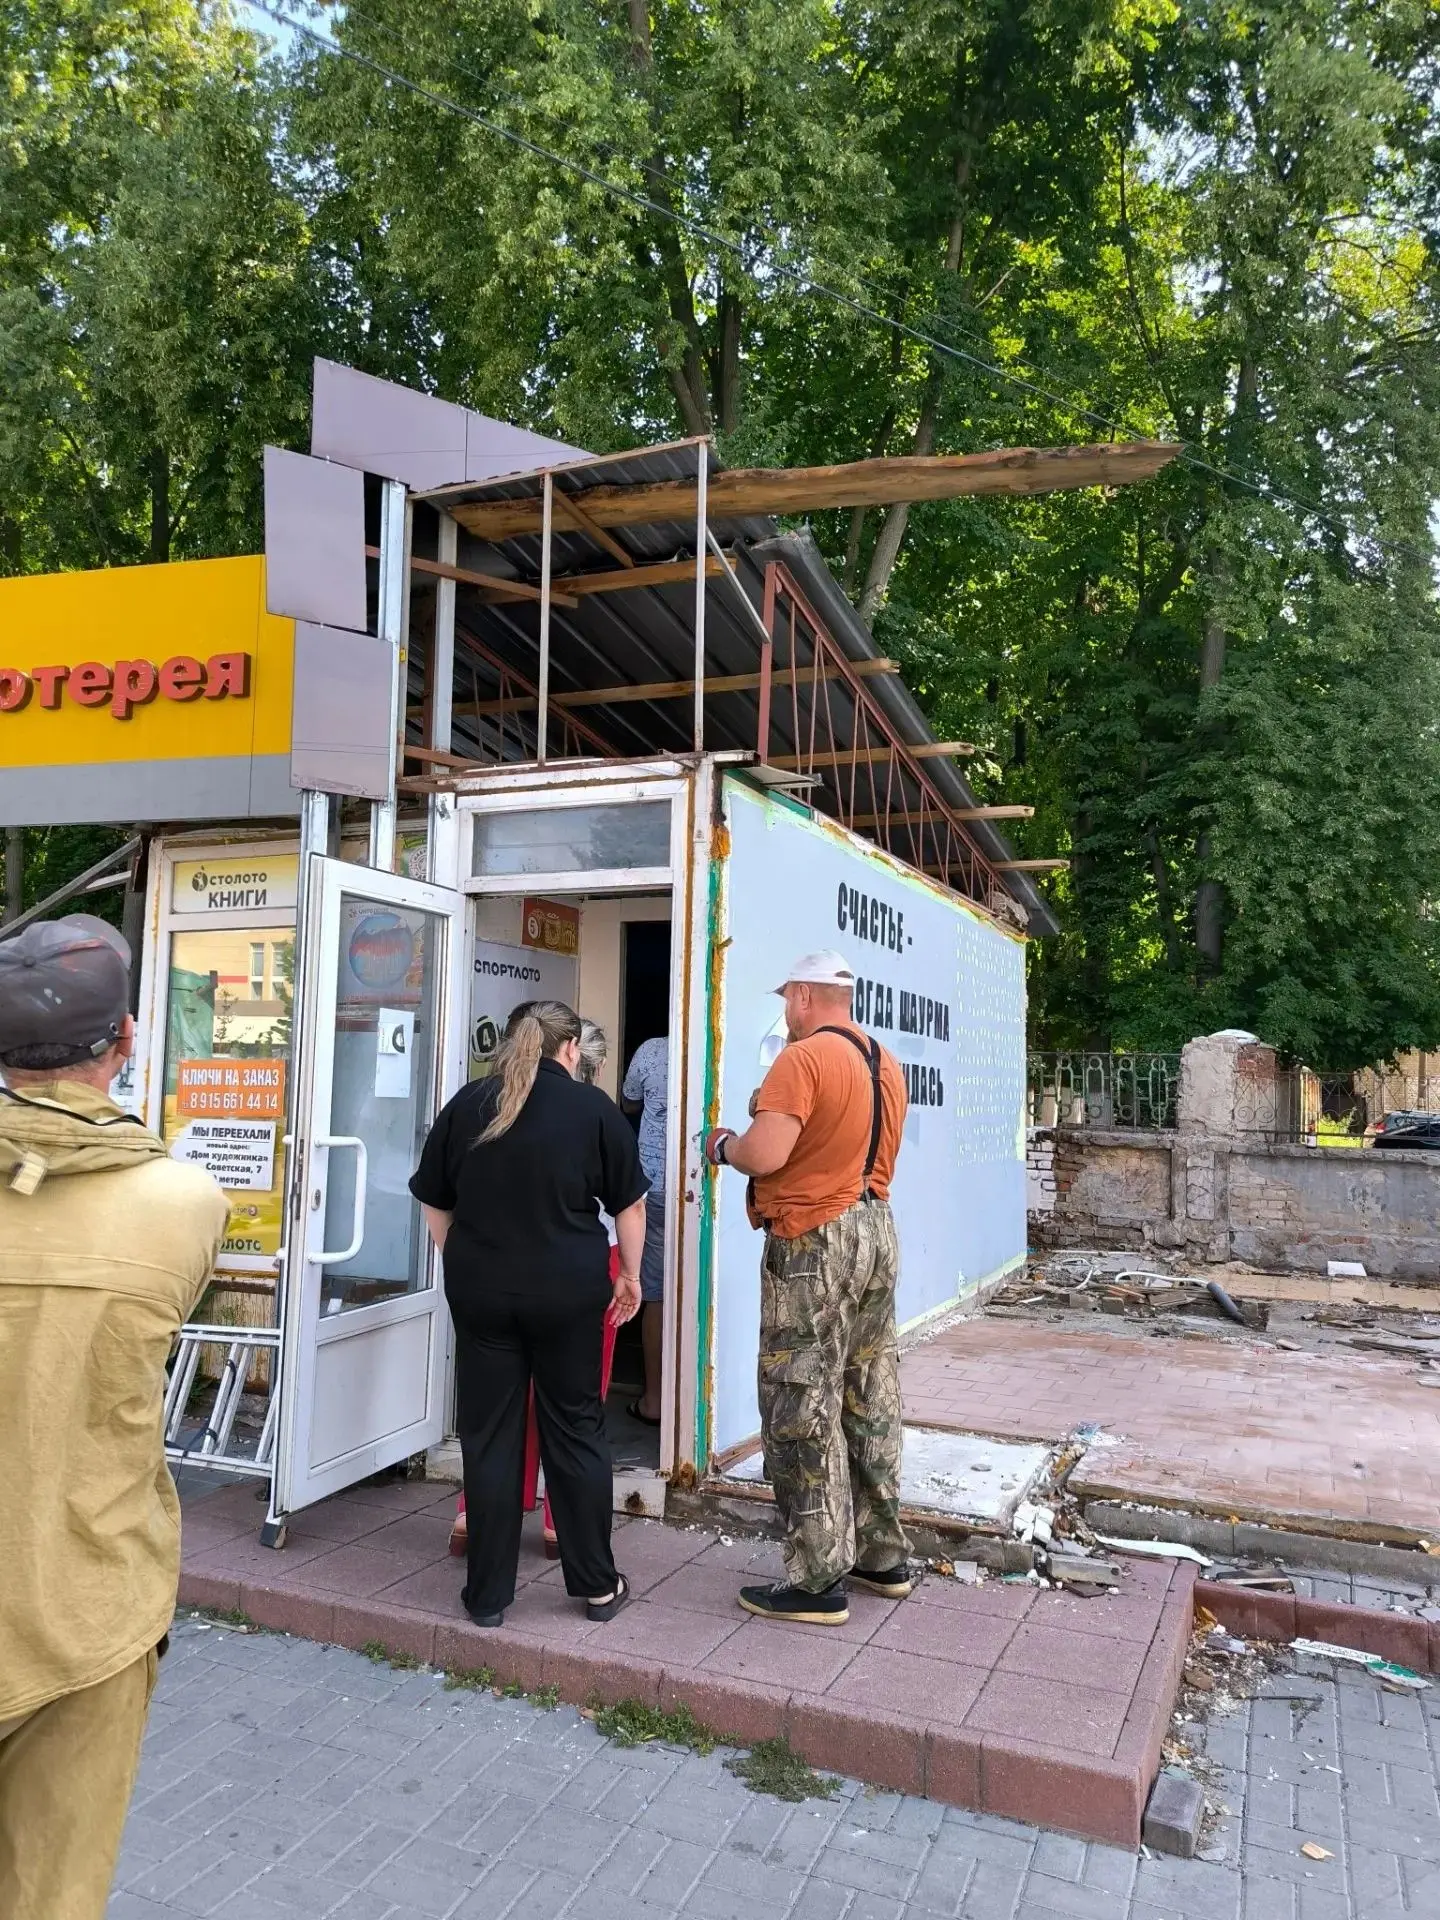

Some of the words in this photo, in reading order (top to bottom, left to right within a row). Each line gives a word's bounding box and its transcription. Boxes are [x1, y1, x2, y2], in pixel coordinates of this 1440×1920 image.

[208, 889, 267, 908] КНИГИ
[837, 881, 904, 954] СЧАСТЬЕ
[474, 959, 541, 982] СПОРТЛОТО
[849, 976, 894, 1030] ОГДА
[899, 990, 950, 1042] ШАУРМА
[182, 1068, 222, 1087] КЛЮЧИ
[224, 1068, 240, 1086] НА
[242, 1068, 280, 1087] ЗАКАЗ
[899, 1062, 944, 1107] ИЛАСЬ
[191, 1126, 210, 1137] МЫ
[211, 1127, 272, 1141] ПЕРЕЕХАЛИ
[186, 1150, 210, 1160] «Дом
[211, 1152, 269, 1162] художника»
[205, 1162, 254, 1174] Советская,
[256, 1165, 262, 1174] 7
[218, 1176, 251, 1186] метров
